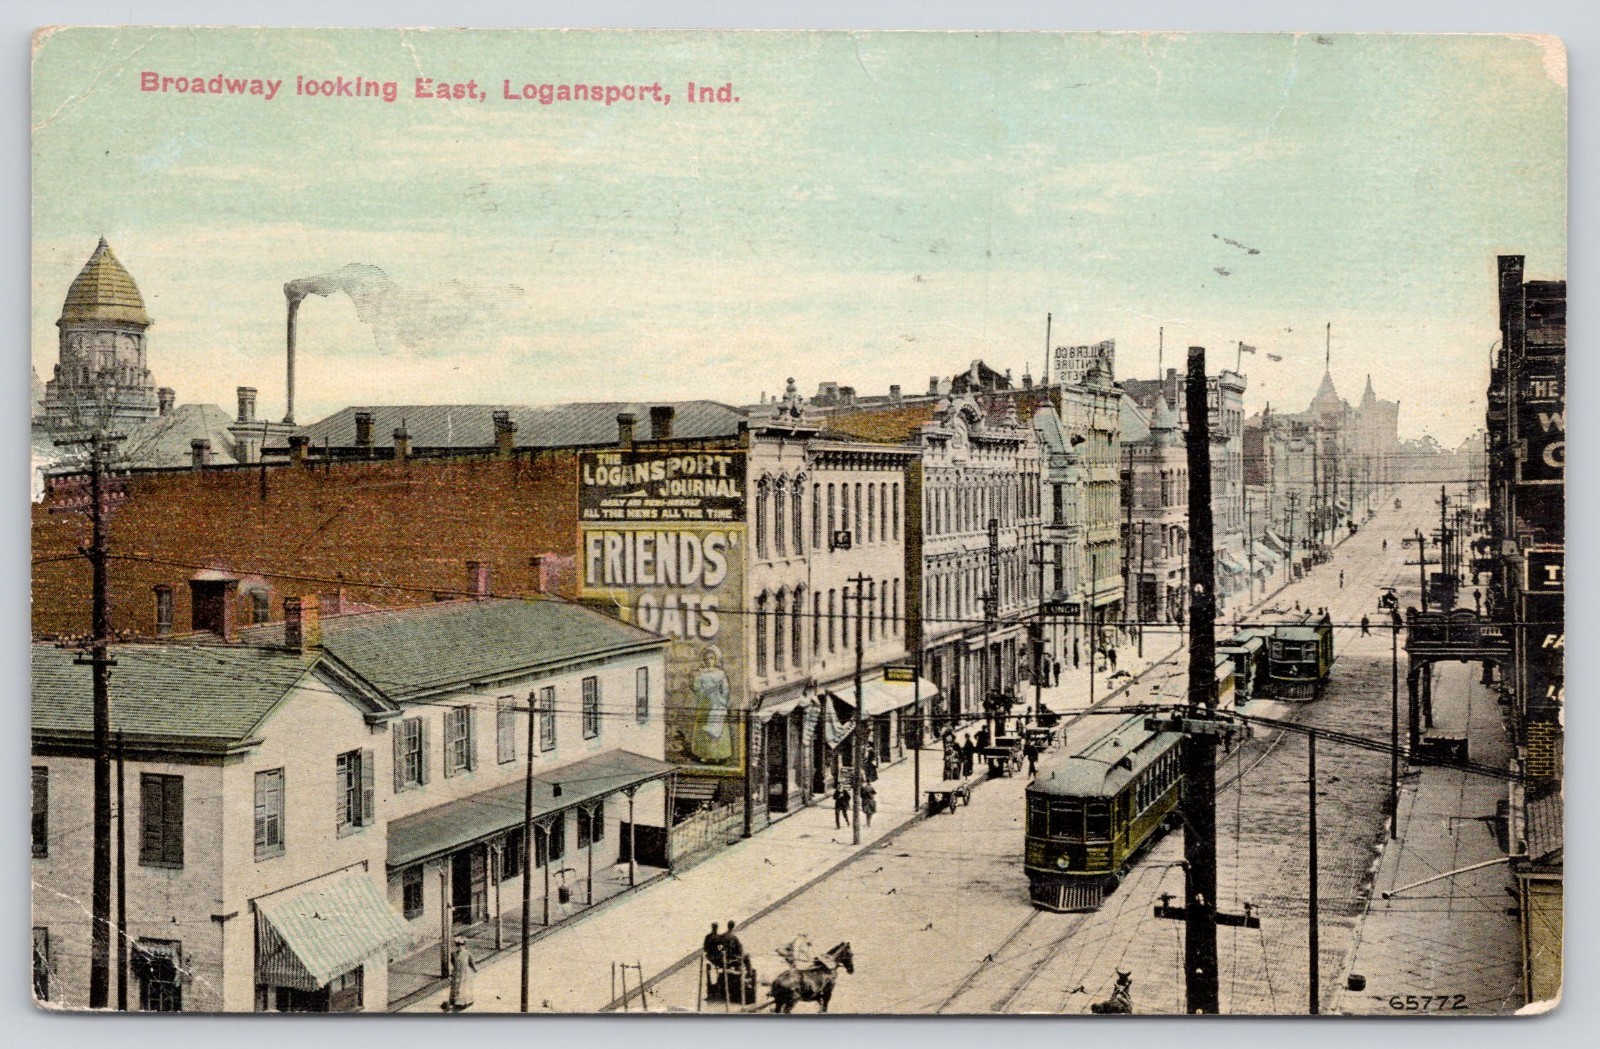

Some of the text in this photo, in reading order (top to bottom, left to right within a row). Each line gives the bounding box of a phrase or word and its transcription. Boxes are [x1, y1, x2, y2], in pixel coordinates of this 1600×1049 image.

[583, 454, 732, 487] LOGANSPORT
[596, 454, 622, 465] THE
[659, 479, 742, 497] JOURNAL
[603, 508, 625, 519] THE
[626, 508, 658, 519] NEWS
[661, 508, 681, 519] ALL
[682, 508, 703, 519] THE
[706, 508, 733, 519] TIME
[585, 530, 738, 587] FRIENDS'
[637, 593, 720, 638] OATS
